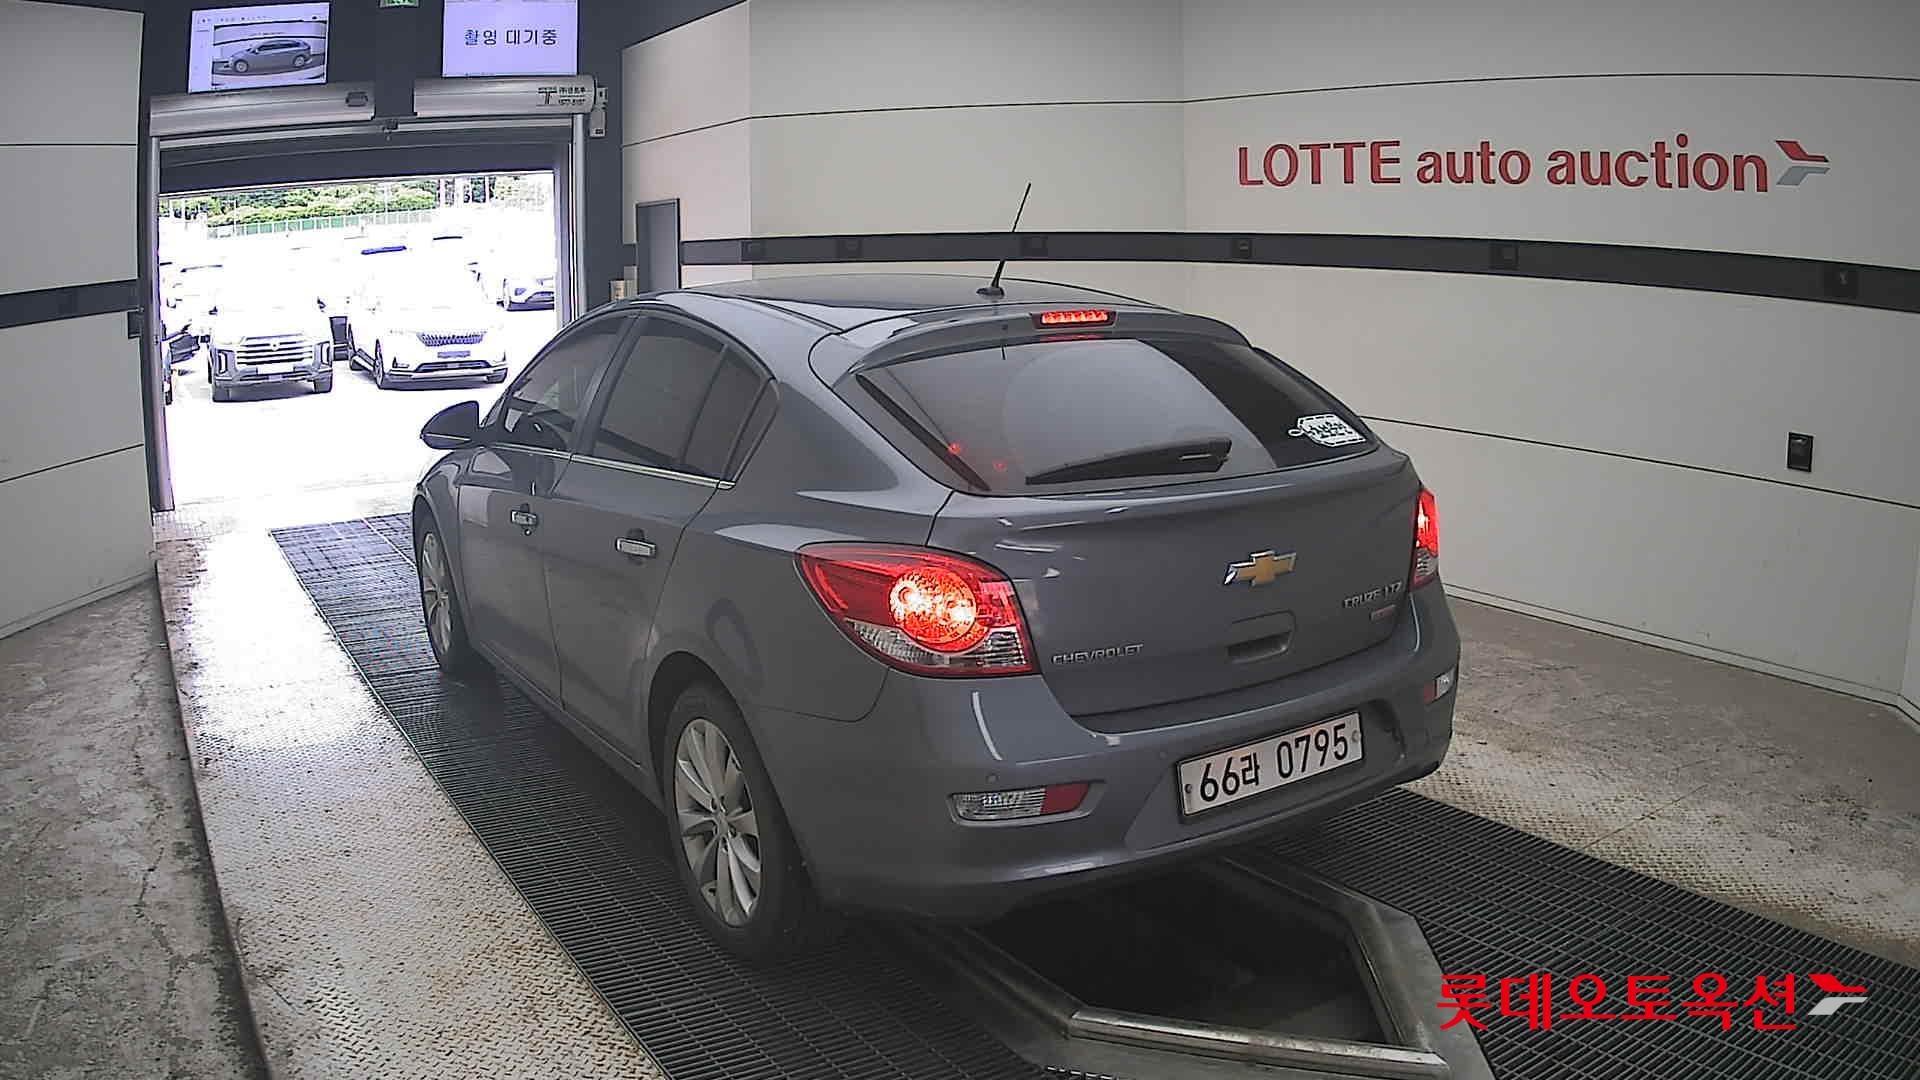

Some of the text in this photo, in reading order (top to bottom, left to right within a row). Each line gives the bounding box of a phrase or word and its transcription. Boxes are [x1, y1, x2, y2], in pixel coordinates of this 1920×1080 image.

[506, 29, 557, 46] 대기중
[1239, 133, 1769, 193] LOTTE auto auction
[1051, 643, 1144, 665] CHEVROLET
[1200, 723, 1349, 803] 66라 0795
